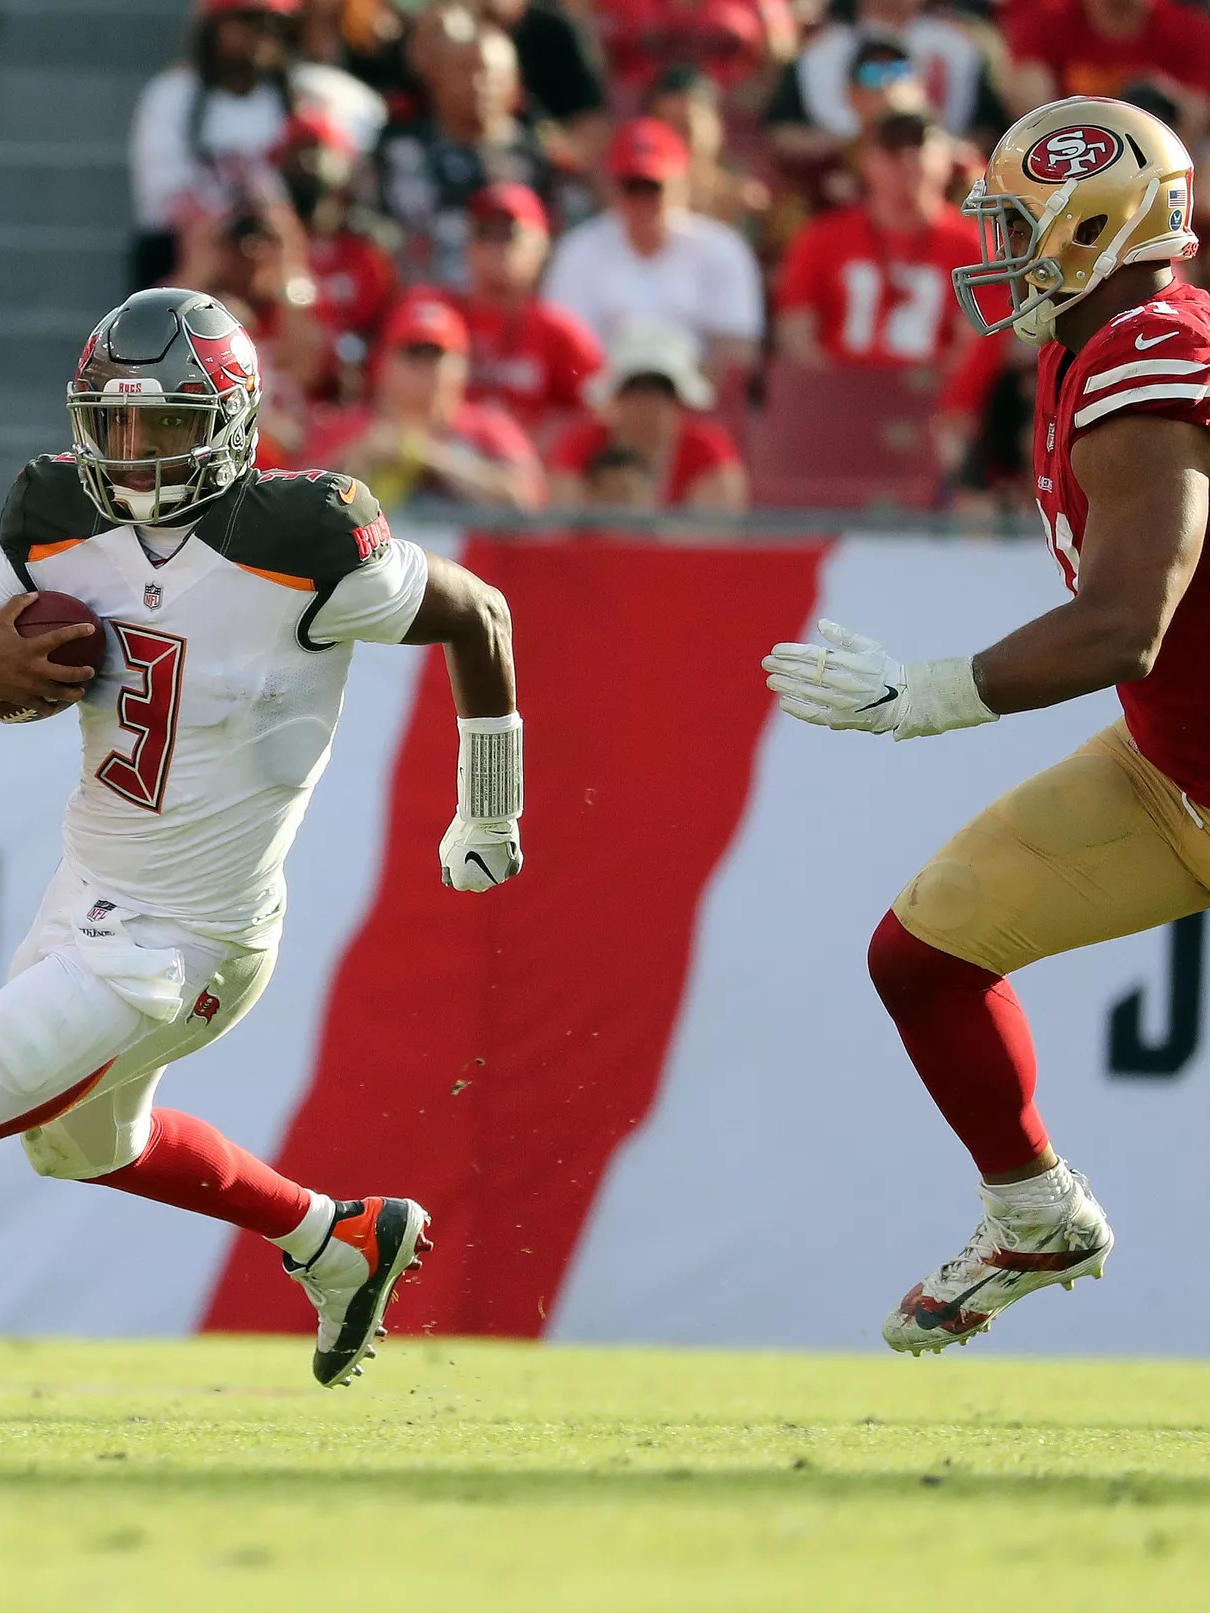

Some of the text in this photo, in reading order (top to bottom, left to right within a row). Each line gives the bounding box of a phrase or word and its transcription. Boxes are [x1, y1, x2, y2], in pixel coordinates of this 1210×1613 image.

[1046, 131, 1106, 176] SF
[118, 383, 142, 393] BUCS
[94, 619, 187, 815] 3
[89, 907, 108, 920] NFL
